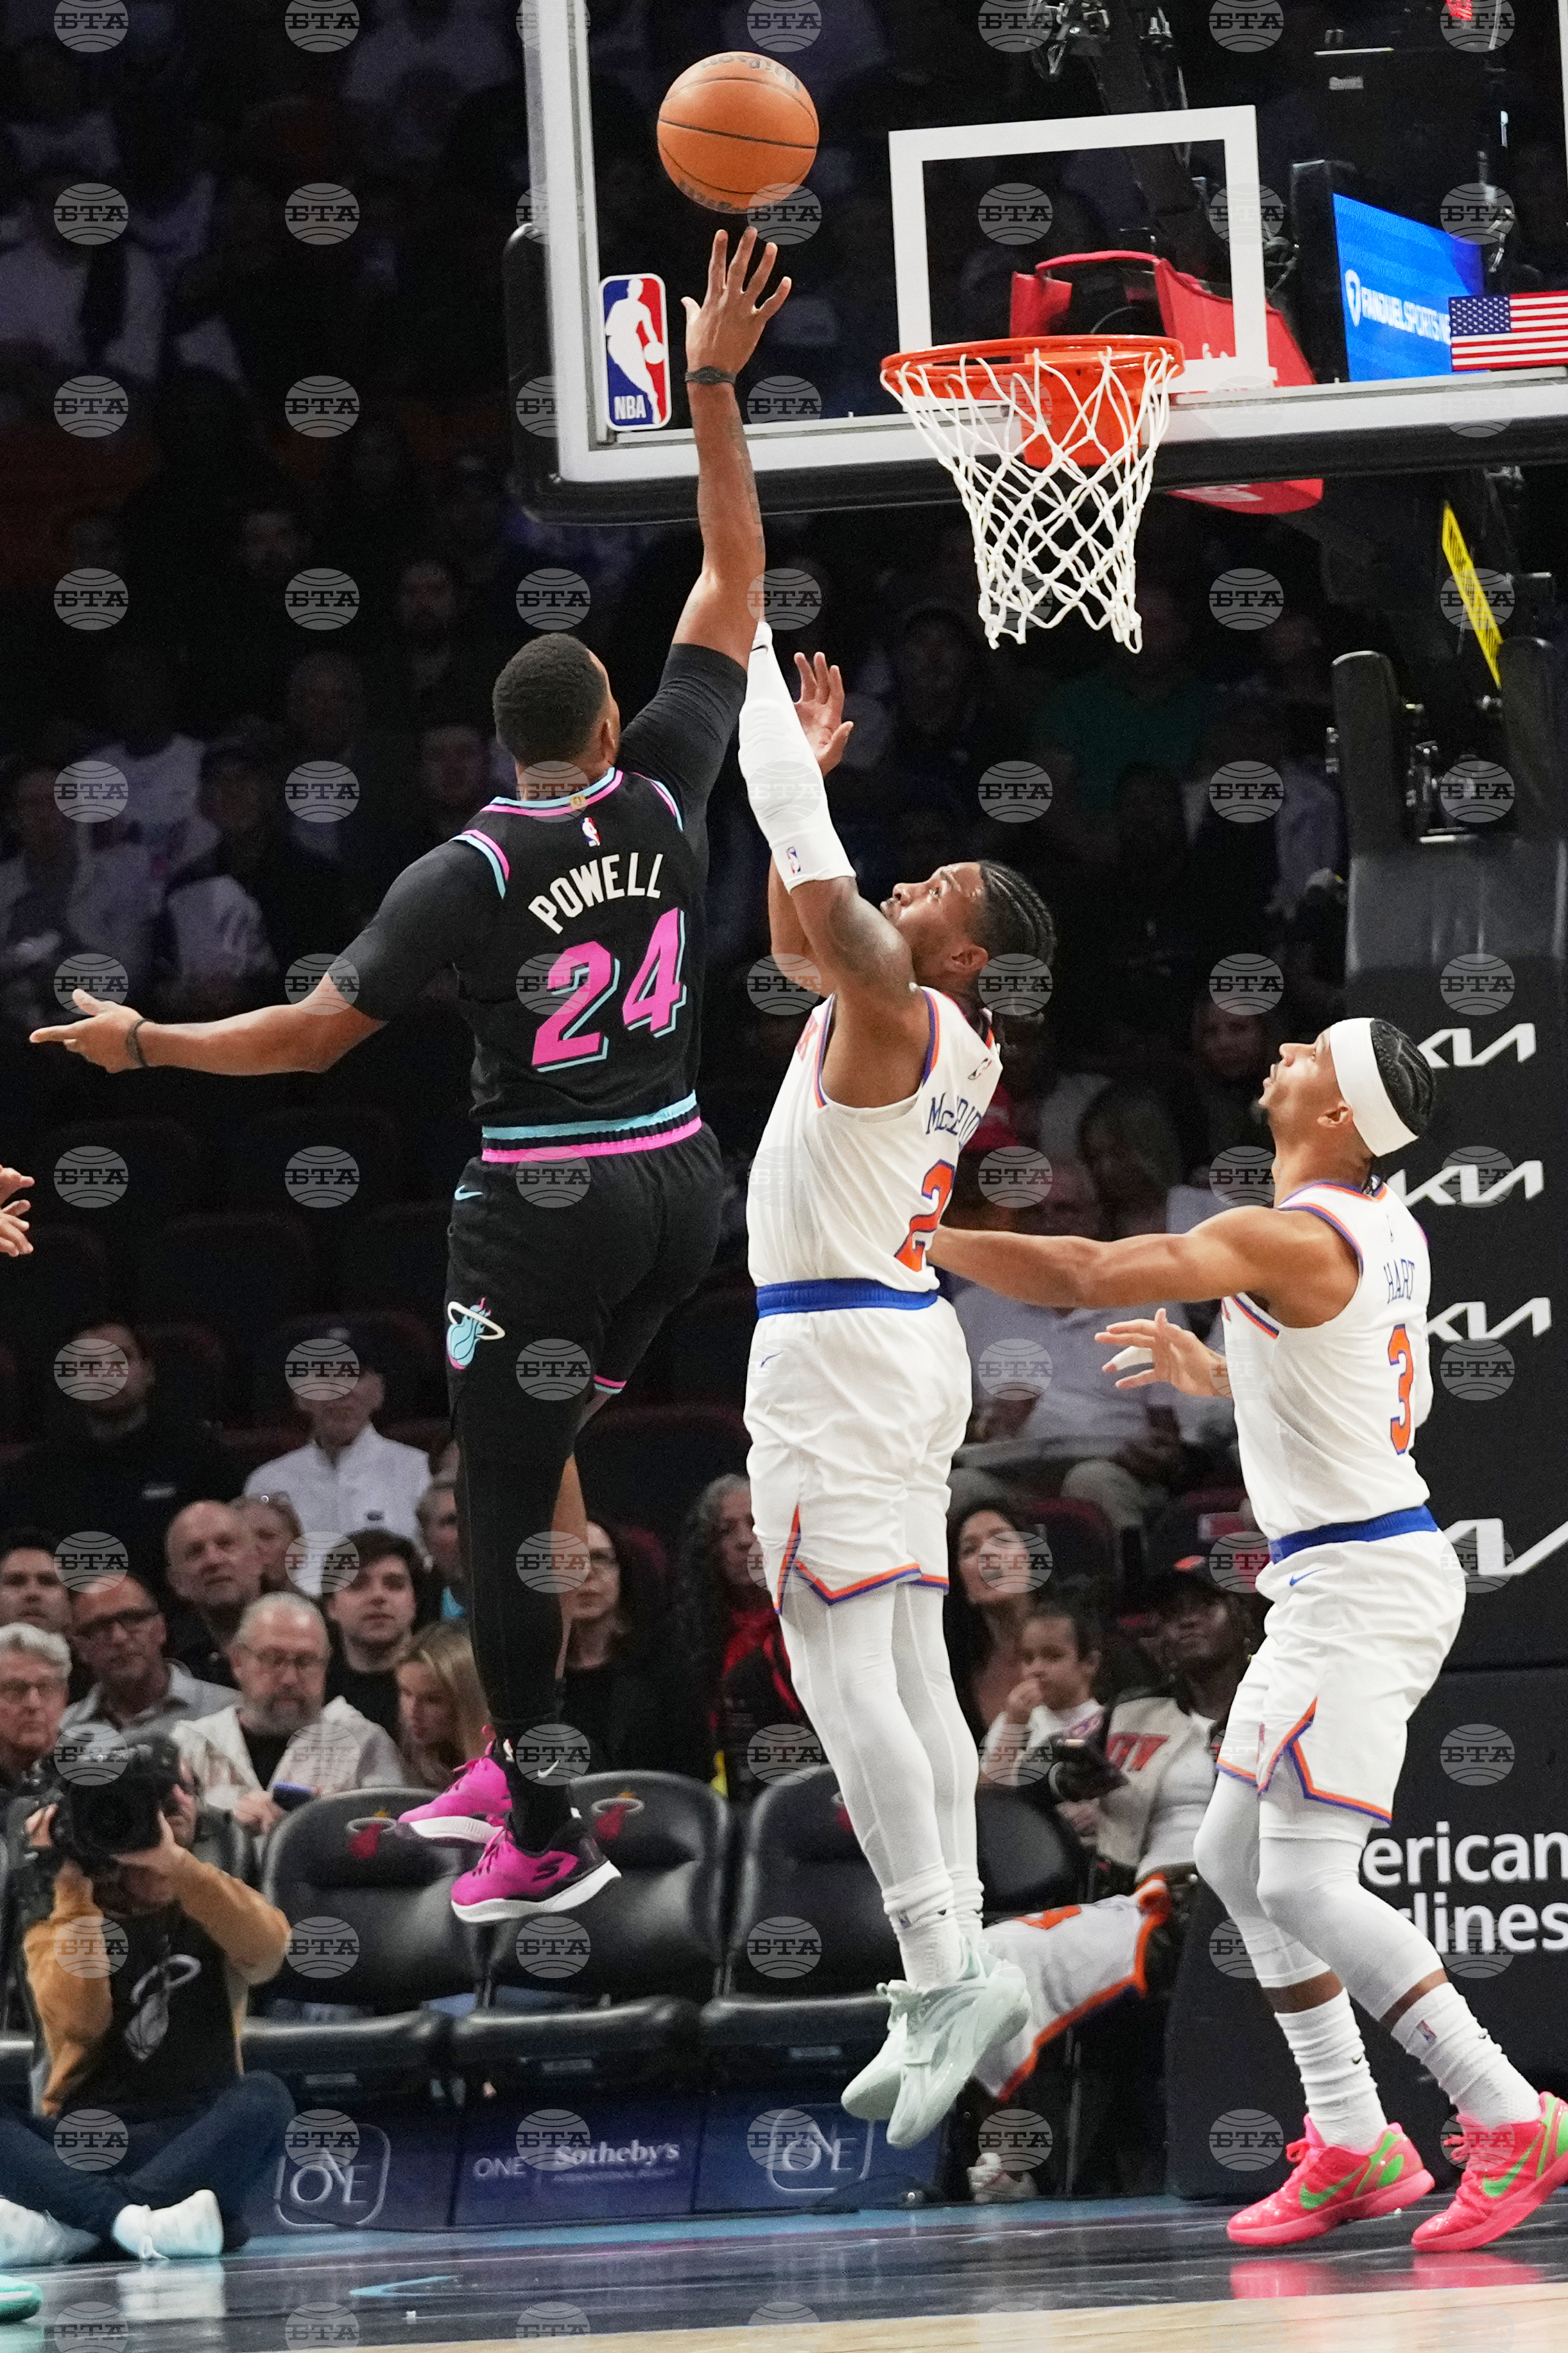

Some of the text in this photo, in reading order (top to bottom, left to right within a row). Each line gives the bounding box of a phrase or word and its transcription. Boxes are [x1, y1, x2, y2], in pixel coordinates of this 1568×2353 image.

[614, 394, 647, 420] NBA
[528, 853, 663, 934] POWELL
[532, 907, 687, 1073] 24
[894, 1159, 955, 1272] 2
[1383, 1258, 1415, 1305] HART
[1388, 1324, 1413, 1455] 3
[1362, 1821, 1568, 1886] erican
[1394, 1892, 1568, 1953] lines
